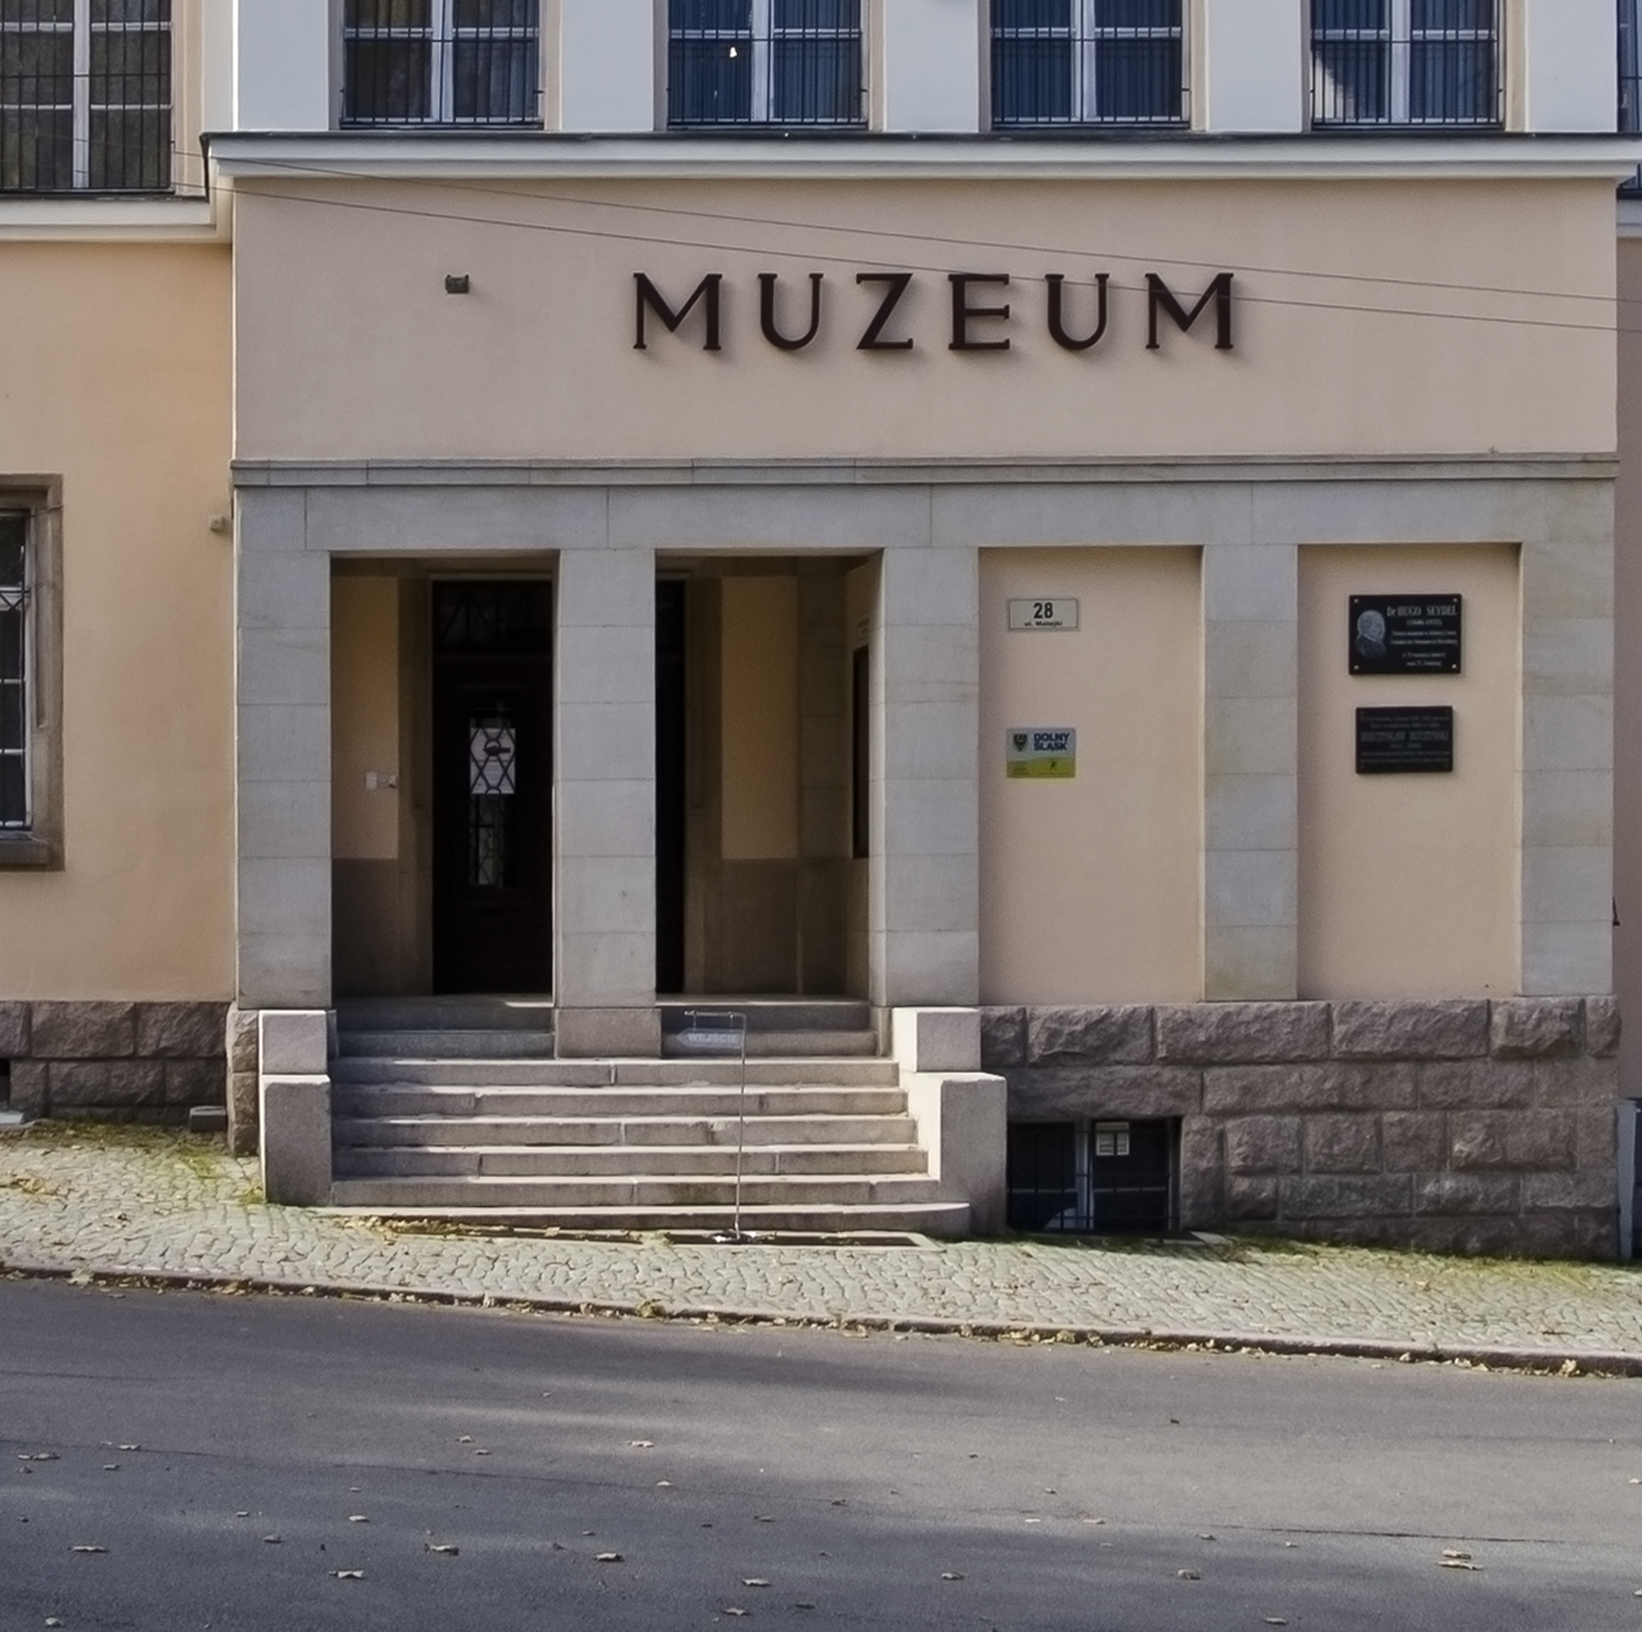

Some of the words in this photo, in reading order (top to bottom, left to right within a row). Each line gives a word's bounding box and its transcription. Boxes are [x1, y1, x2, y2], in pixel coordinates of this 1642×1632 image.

[632, 272, 1235, 351] MUZEUM
[1033, 601, 1054, 619] 28
[1033, 732, 1070, 743] DOLNY
[687, 1031, 739, 1043] WEJŚCIE
